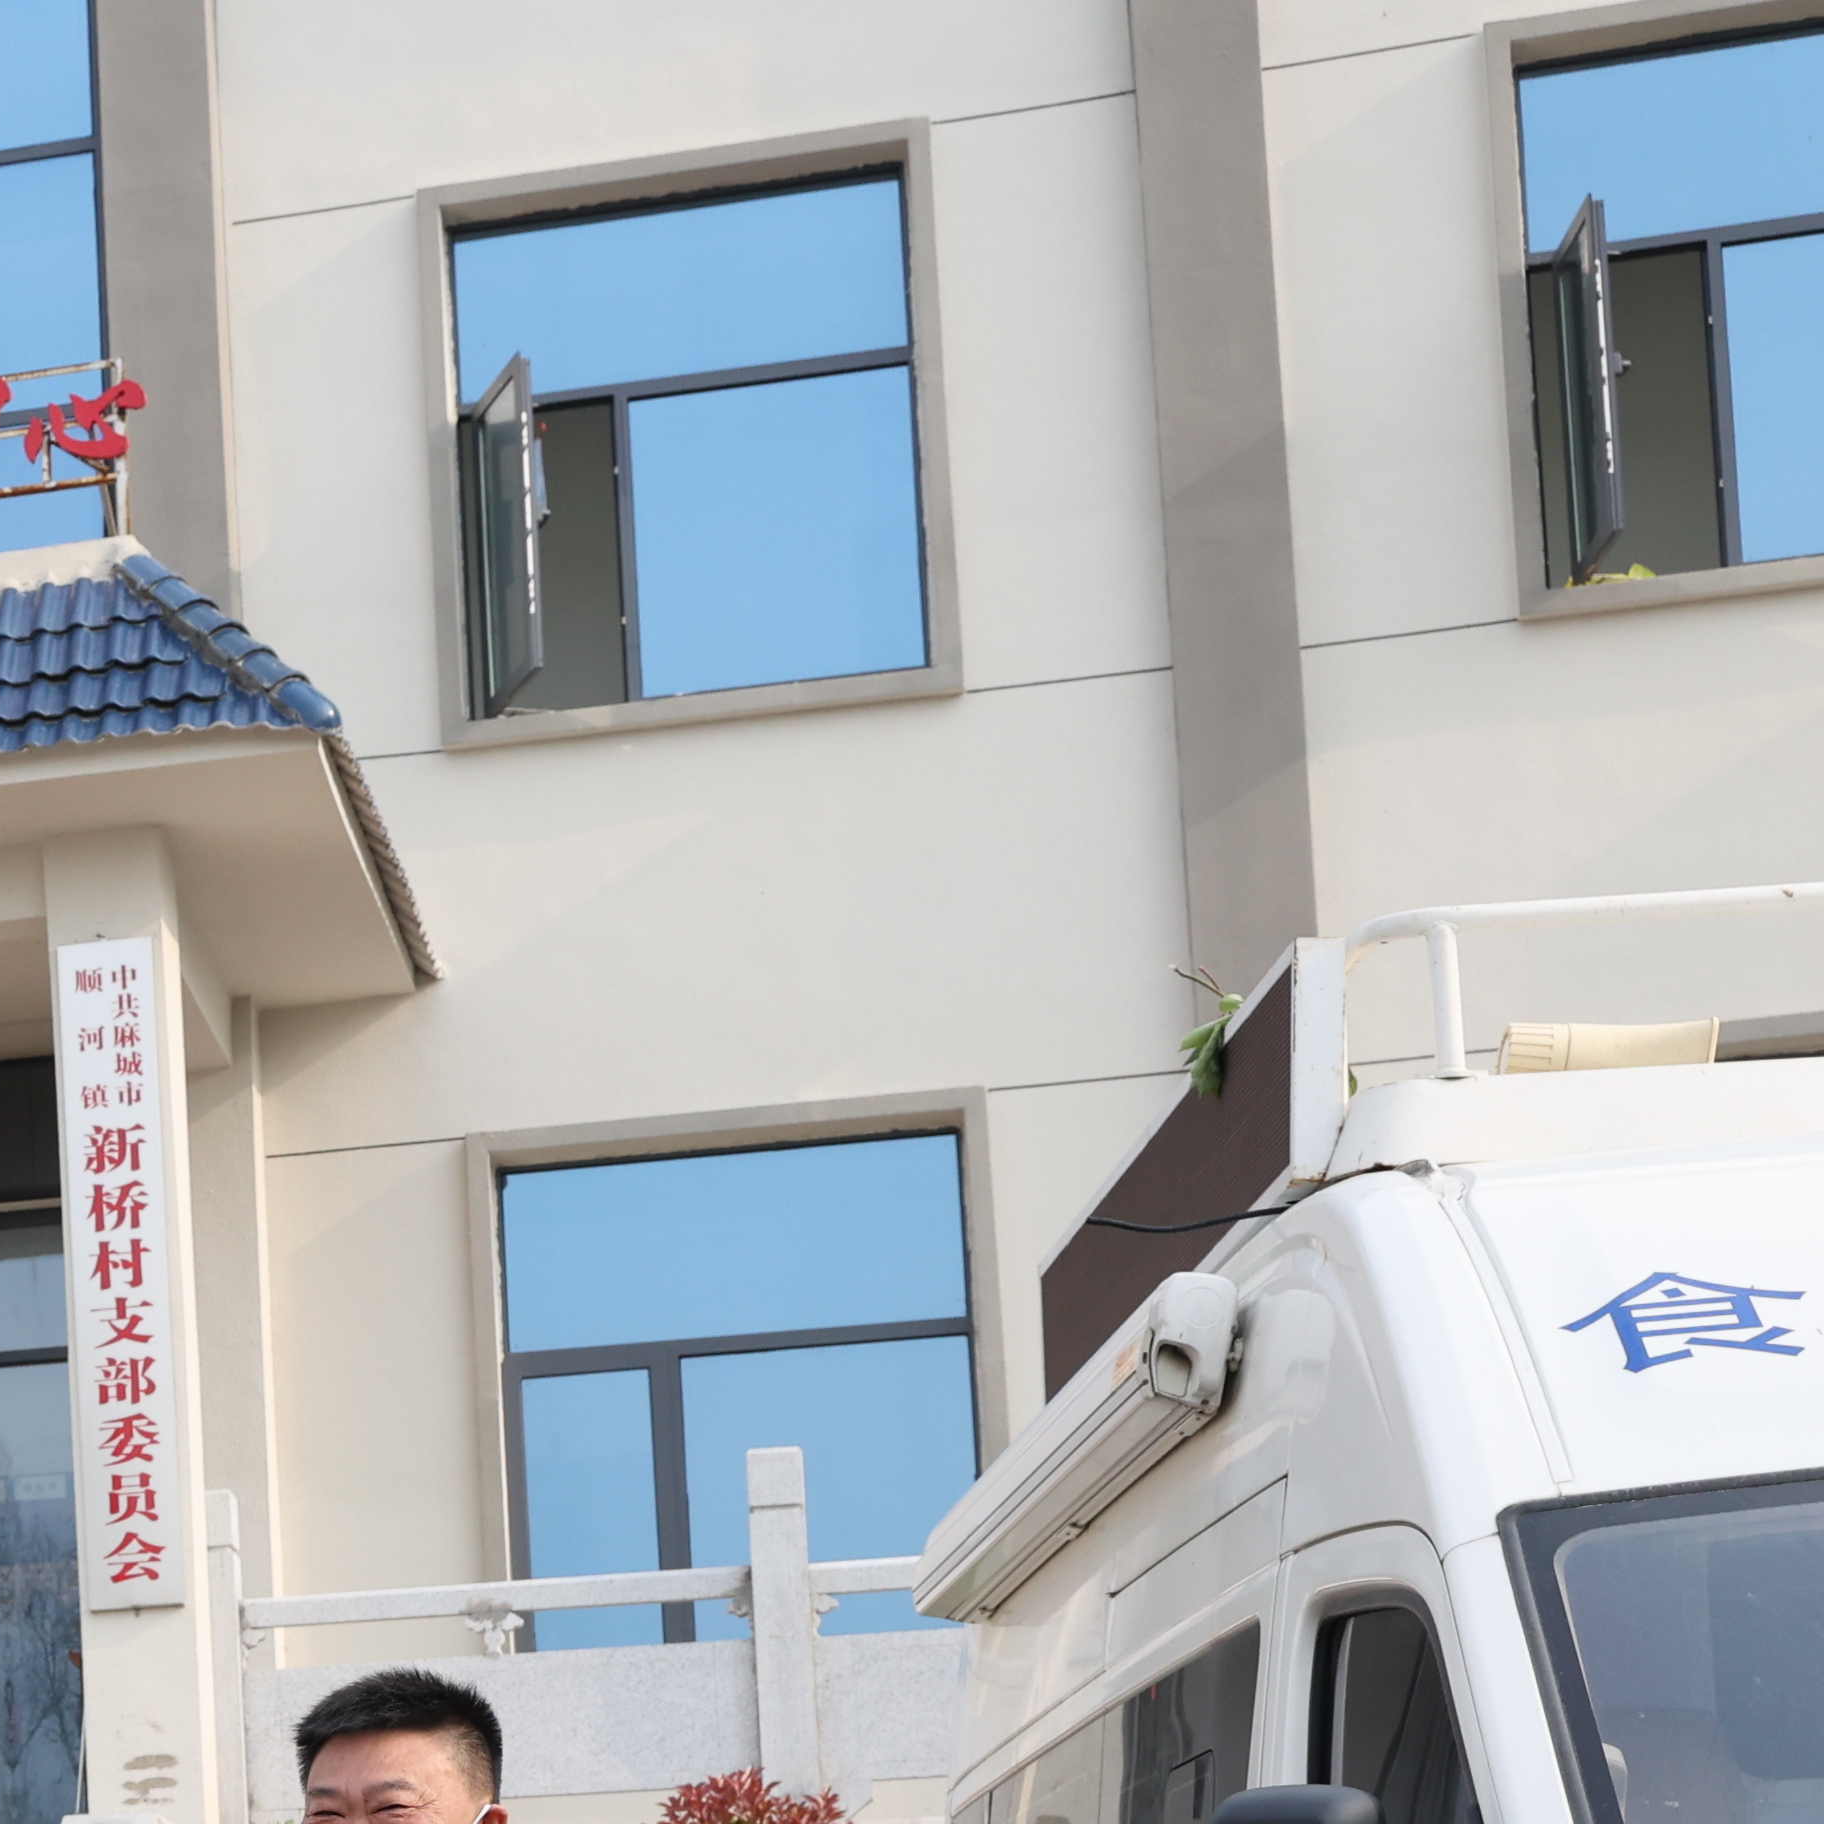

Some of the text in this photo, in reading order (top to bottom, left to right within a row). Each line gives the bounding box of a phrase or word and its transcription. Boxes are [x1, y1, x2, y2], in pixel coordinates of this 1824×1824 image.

[74, 967, 109, 1110] 顺河镇
[110, 964, 144, 1108] 中共麻城市
[83, 1123, 167, 1585] 新桥村支部委员会
[1558, 1271, 1808, 1374] 食
